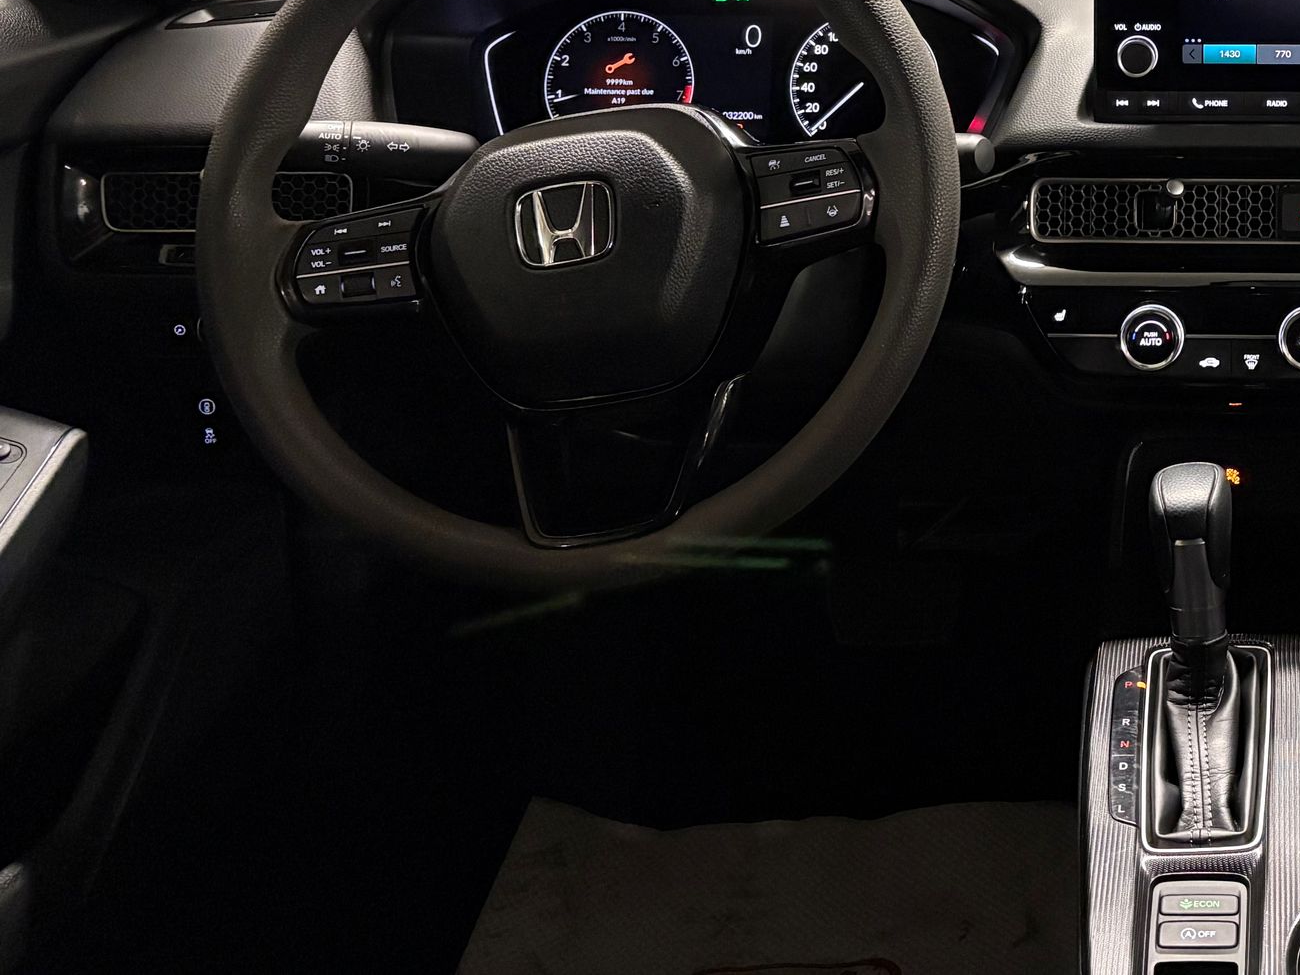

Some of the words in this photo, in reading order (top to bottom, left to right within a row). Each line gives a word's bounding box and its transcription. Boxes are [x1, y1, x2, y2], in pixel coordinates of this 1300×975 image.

[617, 22, 626, 33] 4
[1114, 23, 1128, 31] VOL
[1142, 23, 1162, 31] AUDIO
[583, 32, 592, 44] 3
[651, 32, 660, 44] 5
[745, 24, 762, 48] 0
[814, 45, 829, 55] 80
[1219, 50, 1241, 59] 1430
[1275, 50, 1292, 59] 770
[560, 55, 570, 67] 2
[672, 56, 681, 67] 6
[803, 62, 818, 73] 60
[584, 87, 625, 95] Maintenance
[626, 89, 640, 97] past
[801, 82, 816, 93] 40
[676, 90, 684, 101] 7
[611, 97, 626, 105] A19
[1204, 99, 1228, 107] PHONE
[1266, 100, 1288, 108] RADIO
[805, 103, 820, 113] 20
[318, 132, 342, 140] AUTO
[804, 154, 827, 163] CANCEL
[381, 243, 408, 253] SOURCE
[1122, 718, 1131, 726] R
[1120, 740, 1130, 748] N
[1119, 762, 1128, 770] D
[1117, 783, 1126, 792] S
[1117, 805, 1125, 813] L
[1193, 900, 1220, 908] ECON
[1197, 930, 1217, 938] OFF
